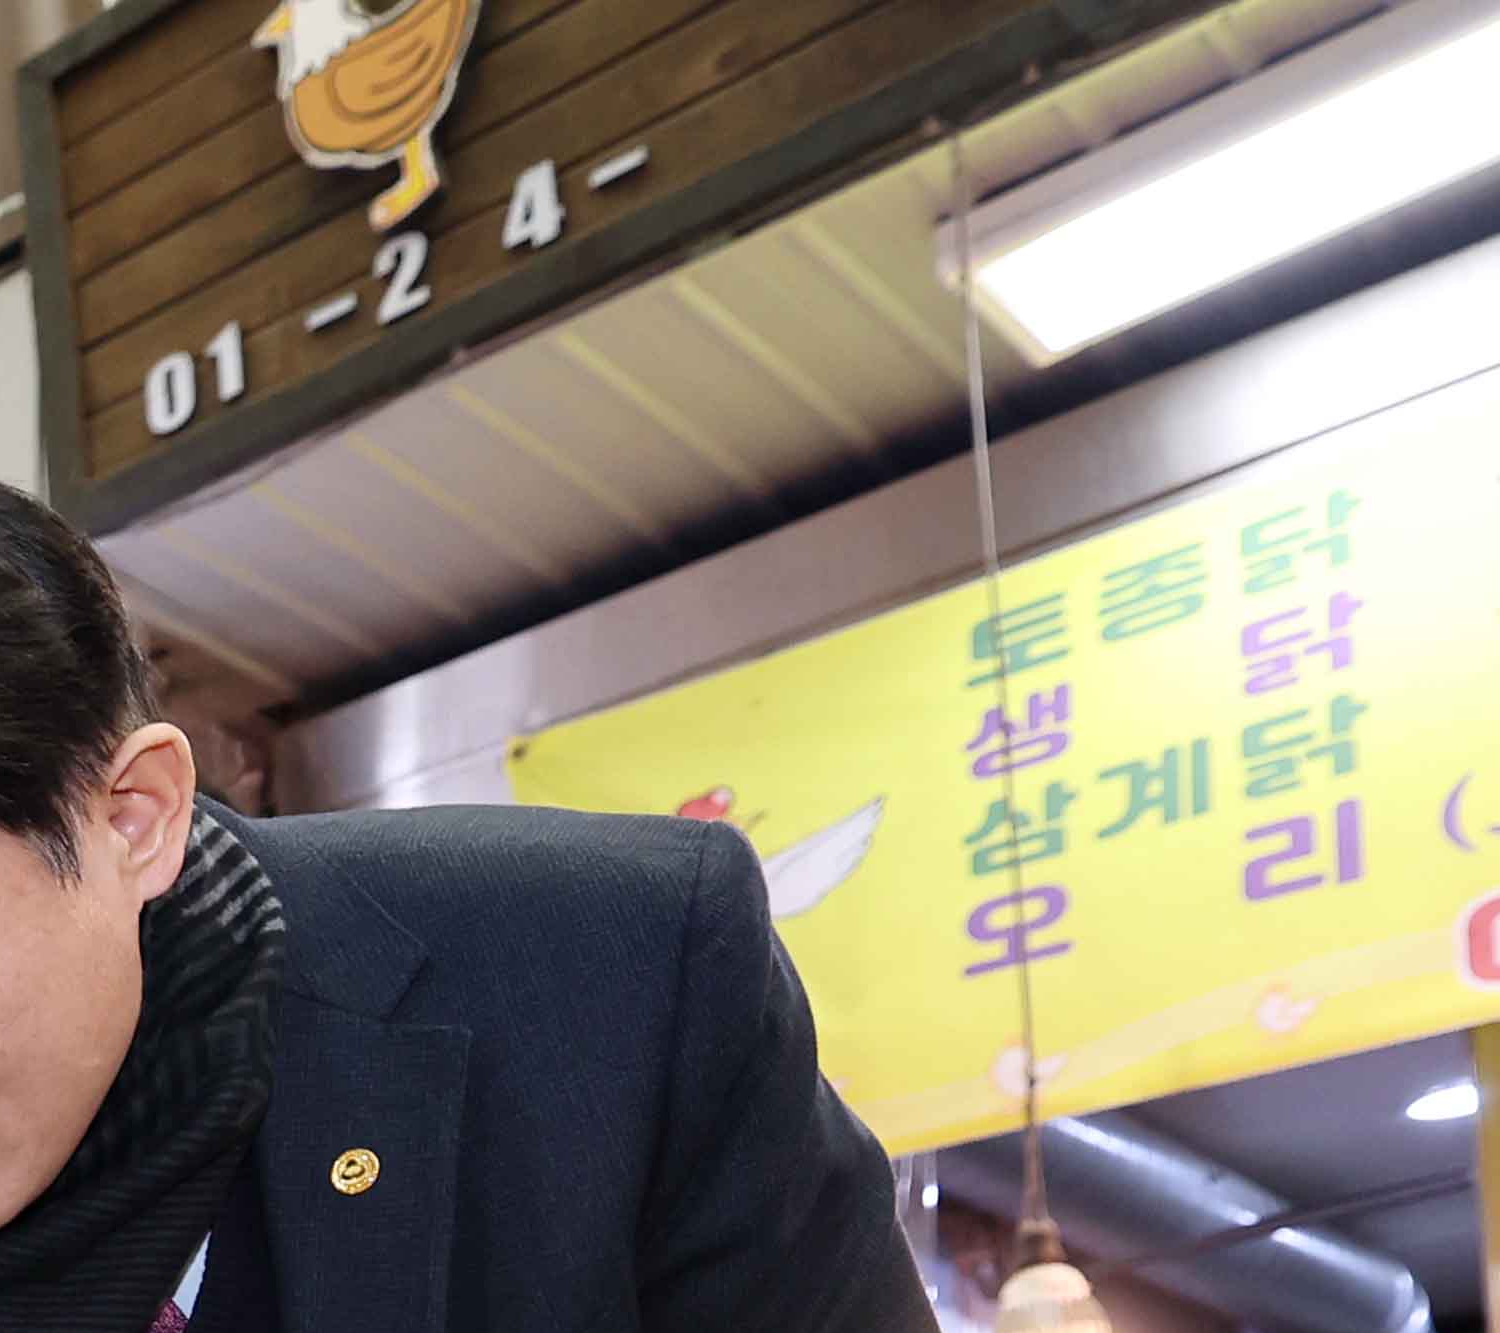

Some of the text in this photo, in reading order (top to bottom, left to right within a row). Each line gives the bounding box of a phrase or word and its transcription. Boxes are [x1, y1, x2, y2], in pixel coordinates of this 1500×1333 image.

[966, 488, 1360, 688] 토종닭
[963, 692, 1369, 877] 삼계닭
[961, 797, 1366, 978] 오리
